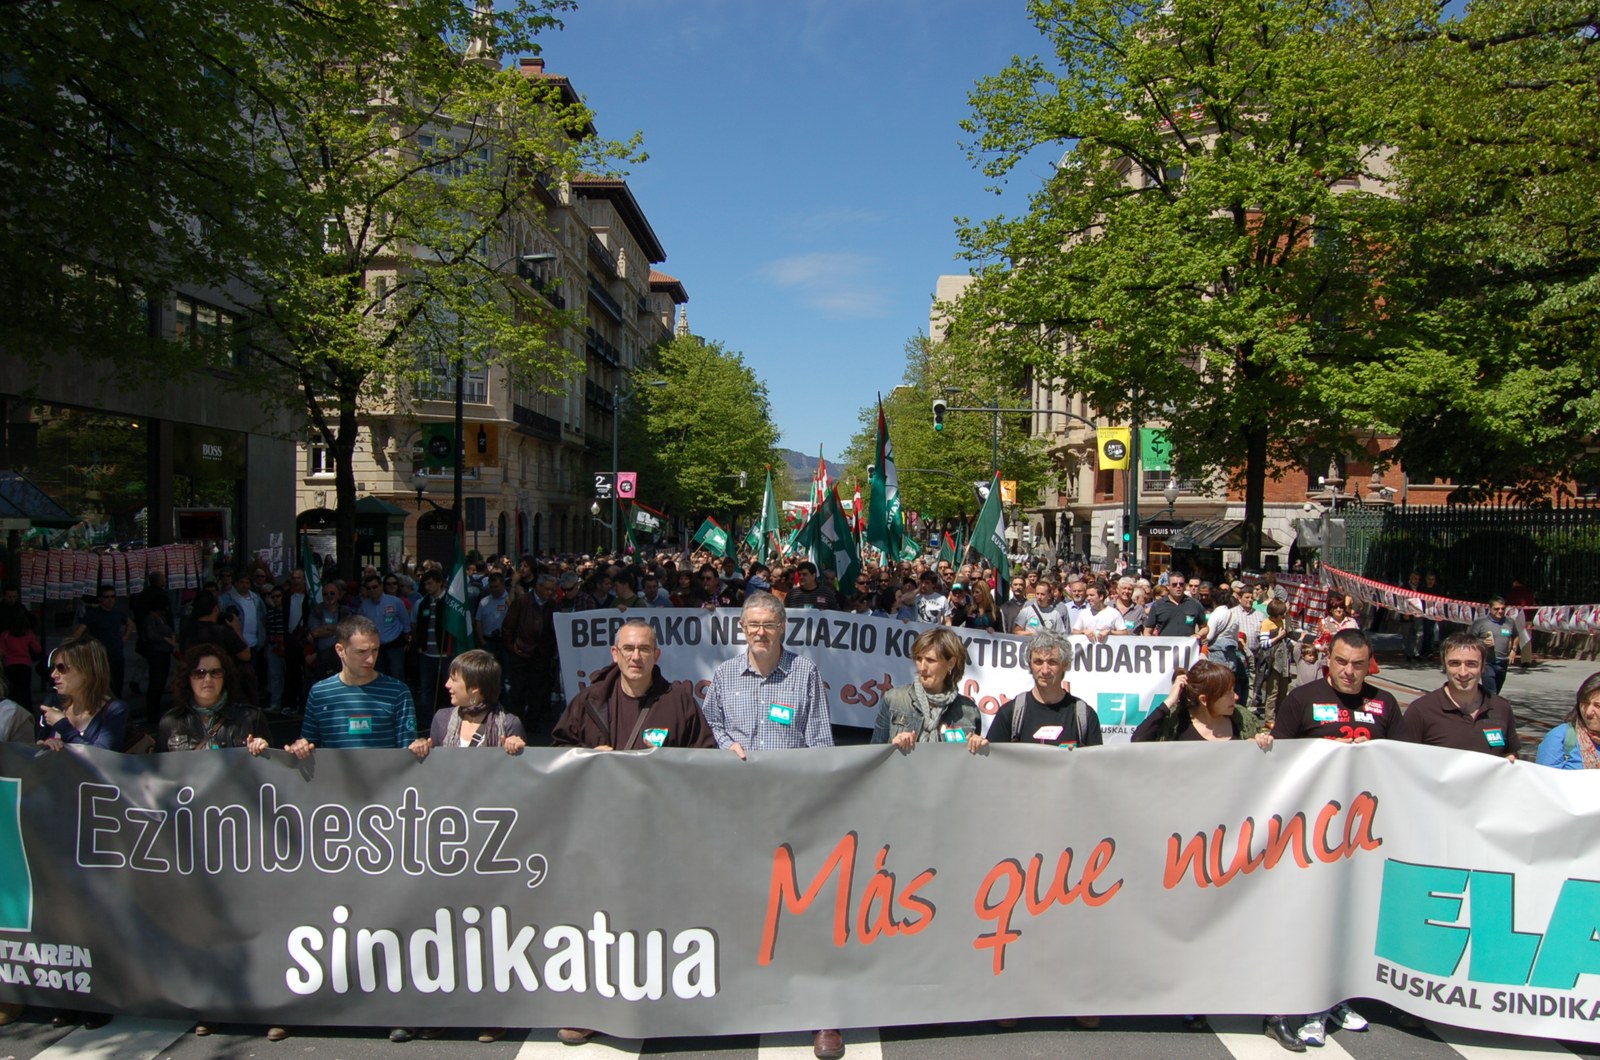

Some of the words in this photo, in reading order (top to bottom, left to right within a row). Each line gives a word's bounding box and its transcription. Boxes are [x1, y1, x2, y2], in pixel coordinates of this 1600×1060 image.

[202, 443, 223, 457] BOSS
[712, 616, 877, 654] NEZIAZIO
[1064, 642, 1191, 674] NDARTU
[1101, 726, 1128, 734] USKAL
[75, 781, 548, 889] Ezinbestez,
[757, 831, 937, 966] Más
[972, 836, 1125, 976] que
[1164, 790, 1384, 891] nunca
[0, 939, 93, 968] TZAREN
[0, 963, 32, 985] NA
[33, 967, 92, 994] 2012
[286, 905, 720, 1002] sindikatua
[1376, 962, 1482, 1010] EUSKAL
[1491, 990, 1600, 1022] SINDIKA
